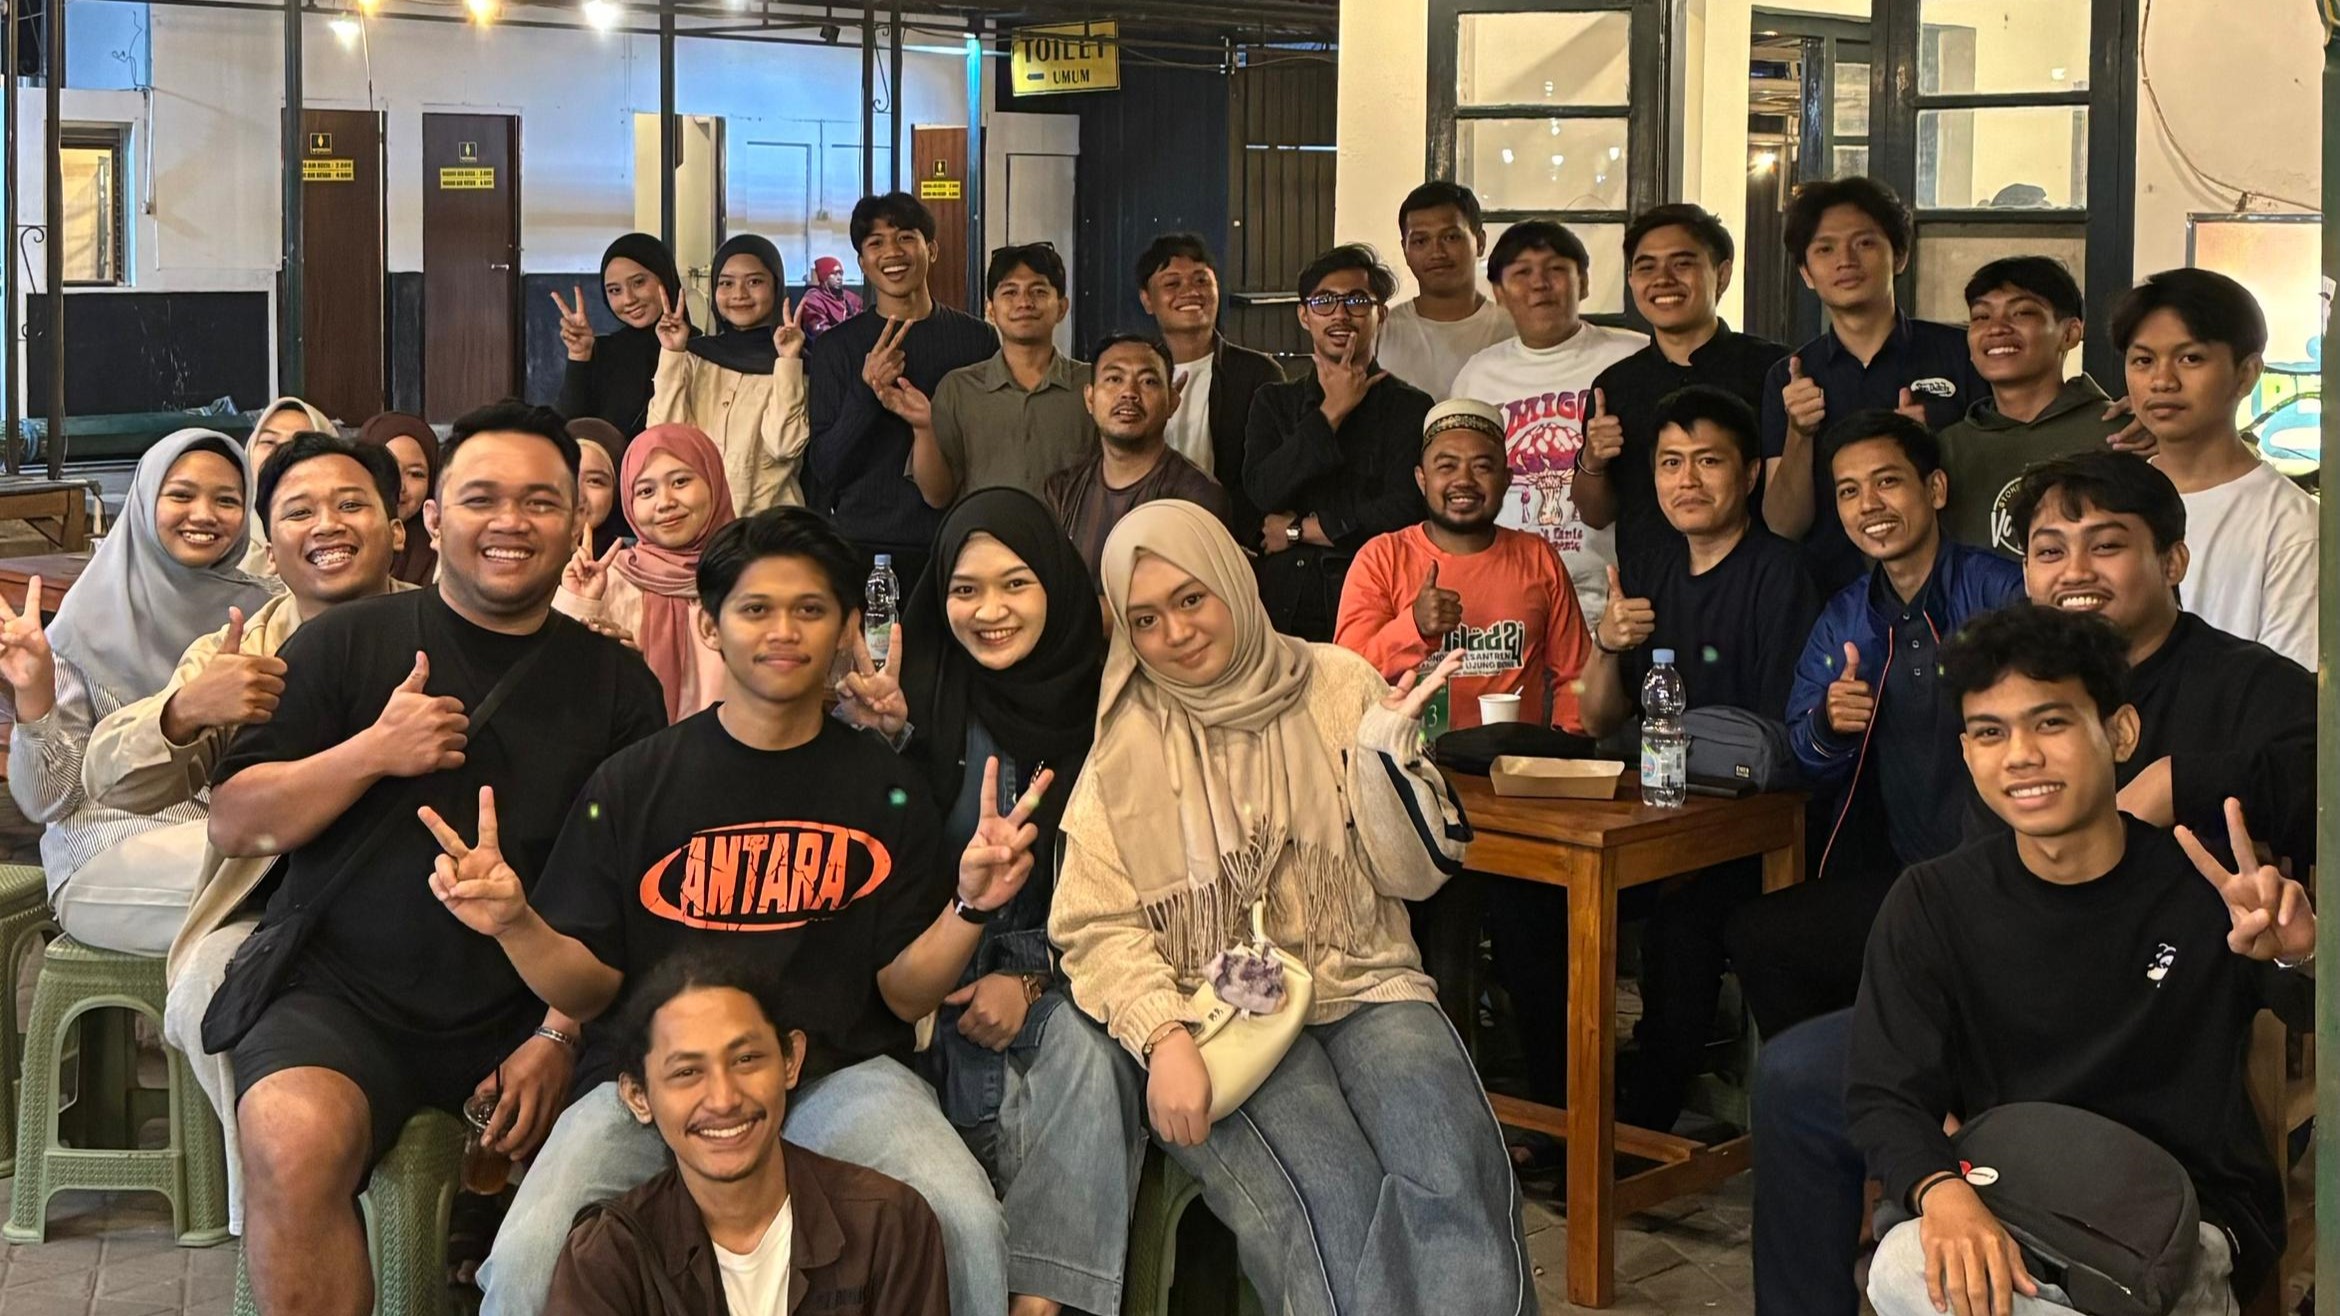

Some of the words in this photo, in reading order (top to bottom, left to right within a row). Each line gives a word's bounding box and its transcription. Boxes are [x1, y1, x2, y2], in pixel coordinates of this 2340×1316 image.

[1021, 36, 1105, 63] TOILET
[1053, 68, 1090, 84] UMUM
[680, 831, 850, 917] ANTARA
